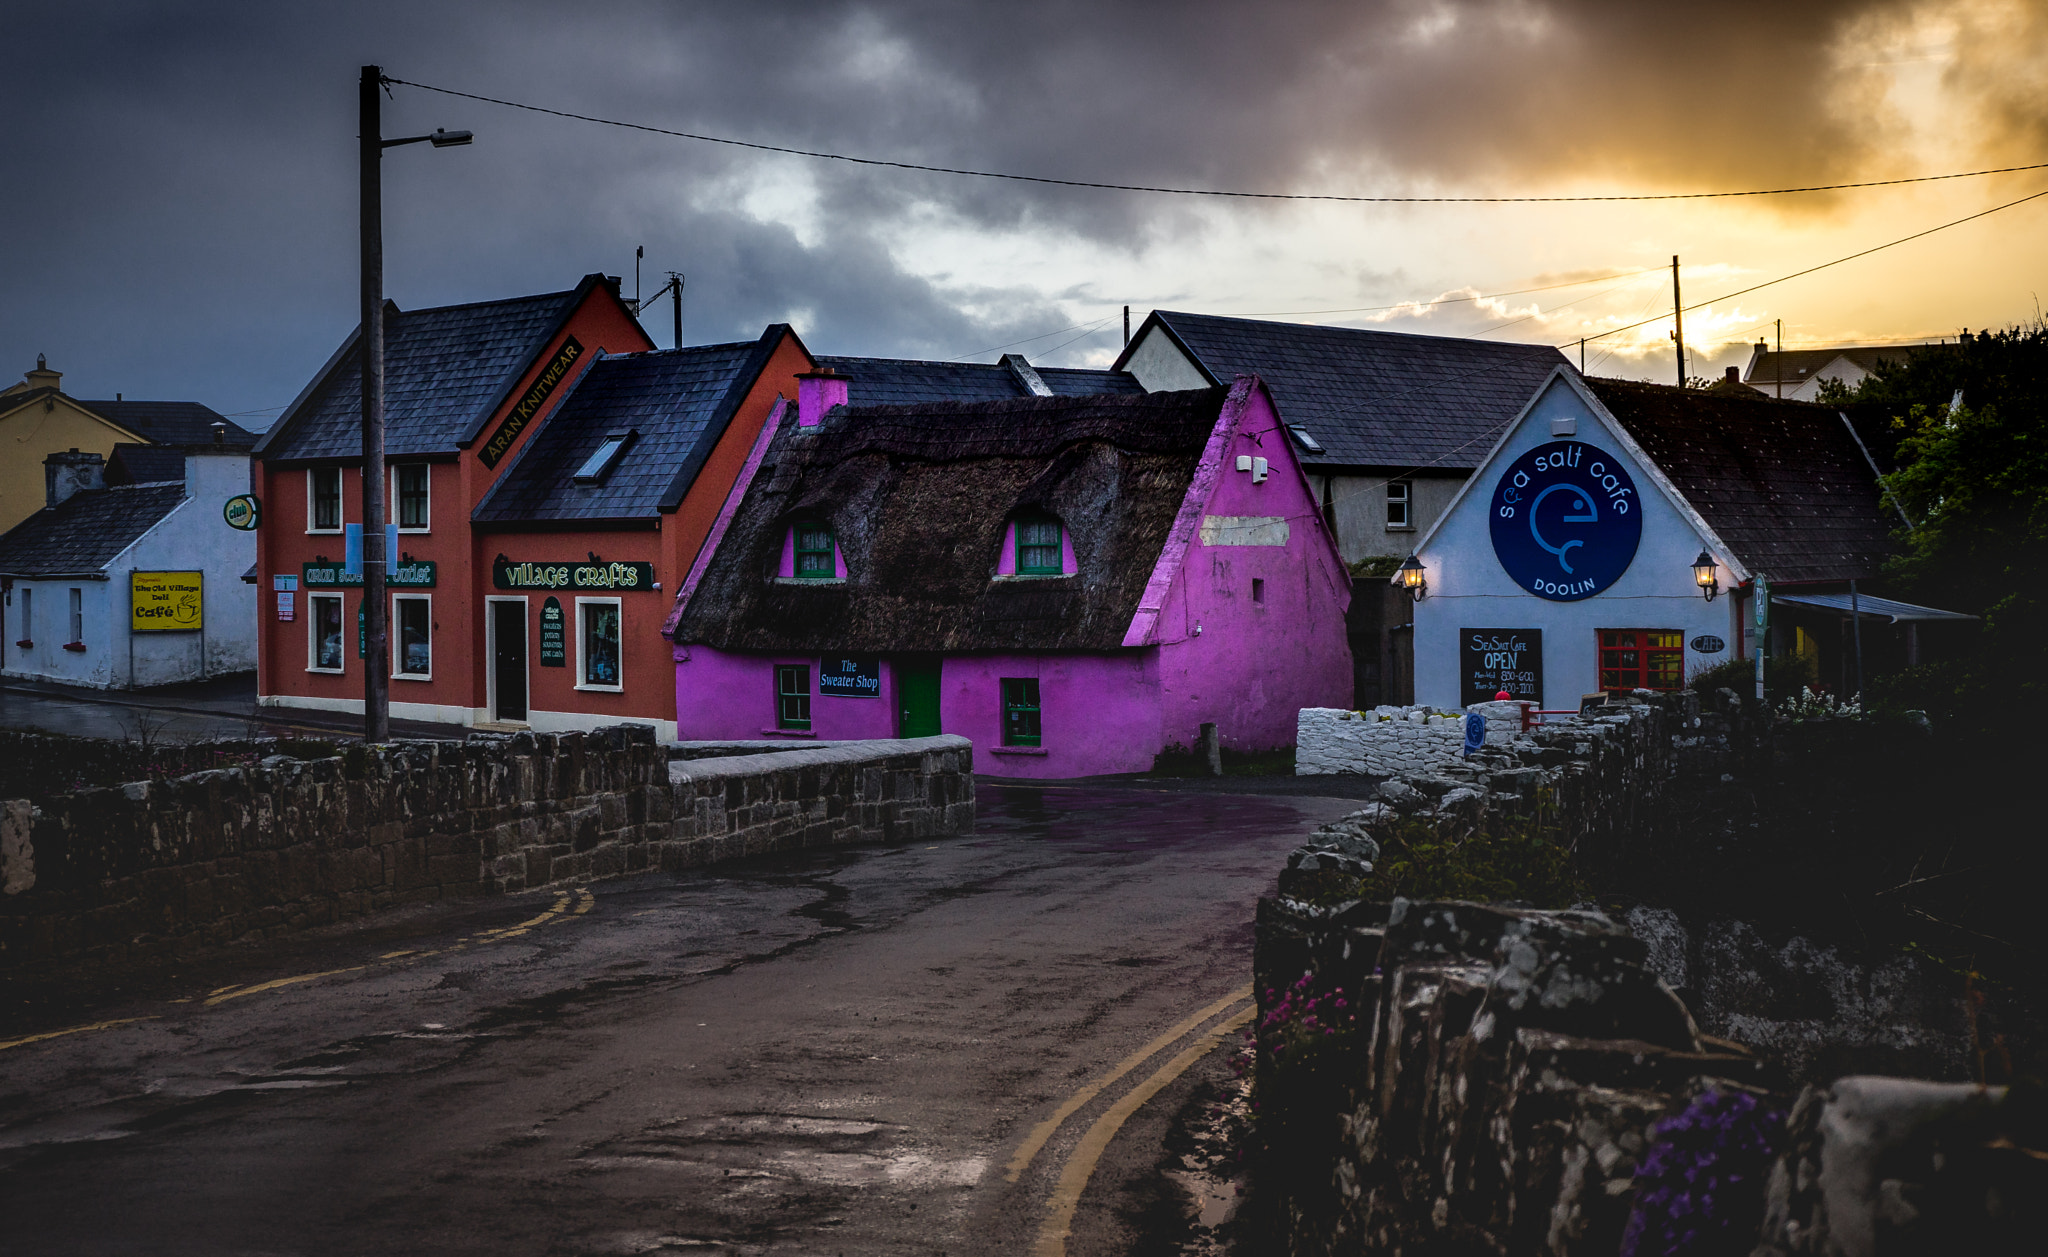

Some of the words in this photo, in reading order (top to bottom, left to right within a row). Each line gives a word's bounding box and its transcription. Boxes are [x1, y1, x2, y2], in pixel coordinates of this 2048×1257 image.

[488, 416, 523, 461] ARAN
[517, 345, 578, 419] KNITWEAR
[1500, 469, 1531, 519] sea
[1534, 444, 1583, 472] salt
[1590, 461, 1632, 515] cafe
[169, 585, 199, 593] Village
[1534, 577, 1596, 596] DOOLIN
[152, 593, 169, 601] Deli
[135, 606, 174, 618] Café
[1692, 636, 1724, 651] CAFE
[841, 659, 857, 673] The
[1484, 652, 1518, 670] OPEN
[820, 673, 856, 688] Sweater
[855, 674, 878, 692] Shop
